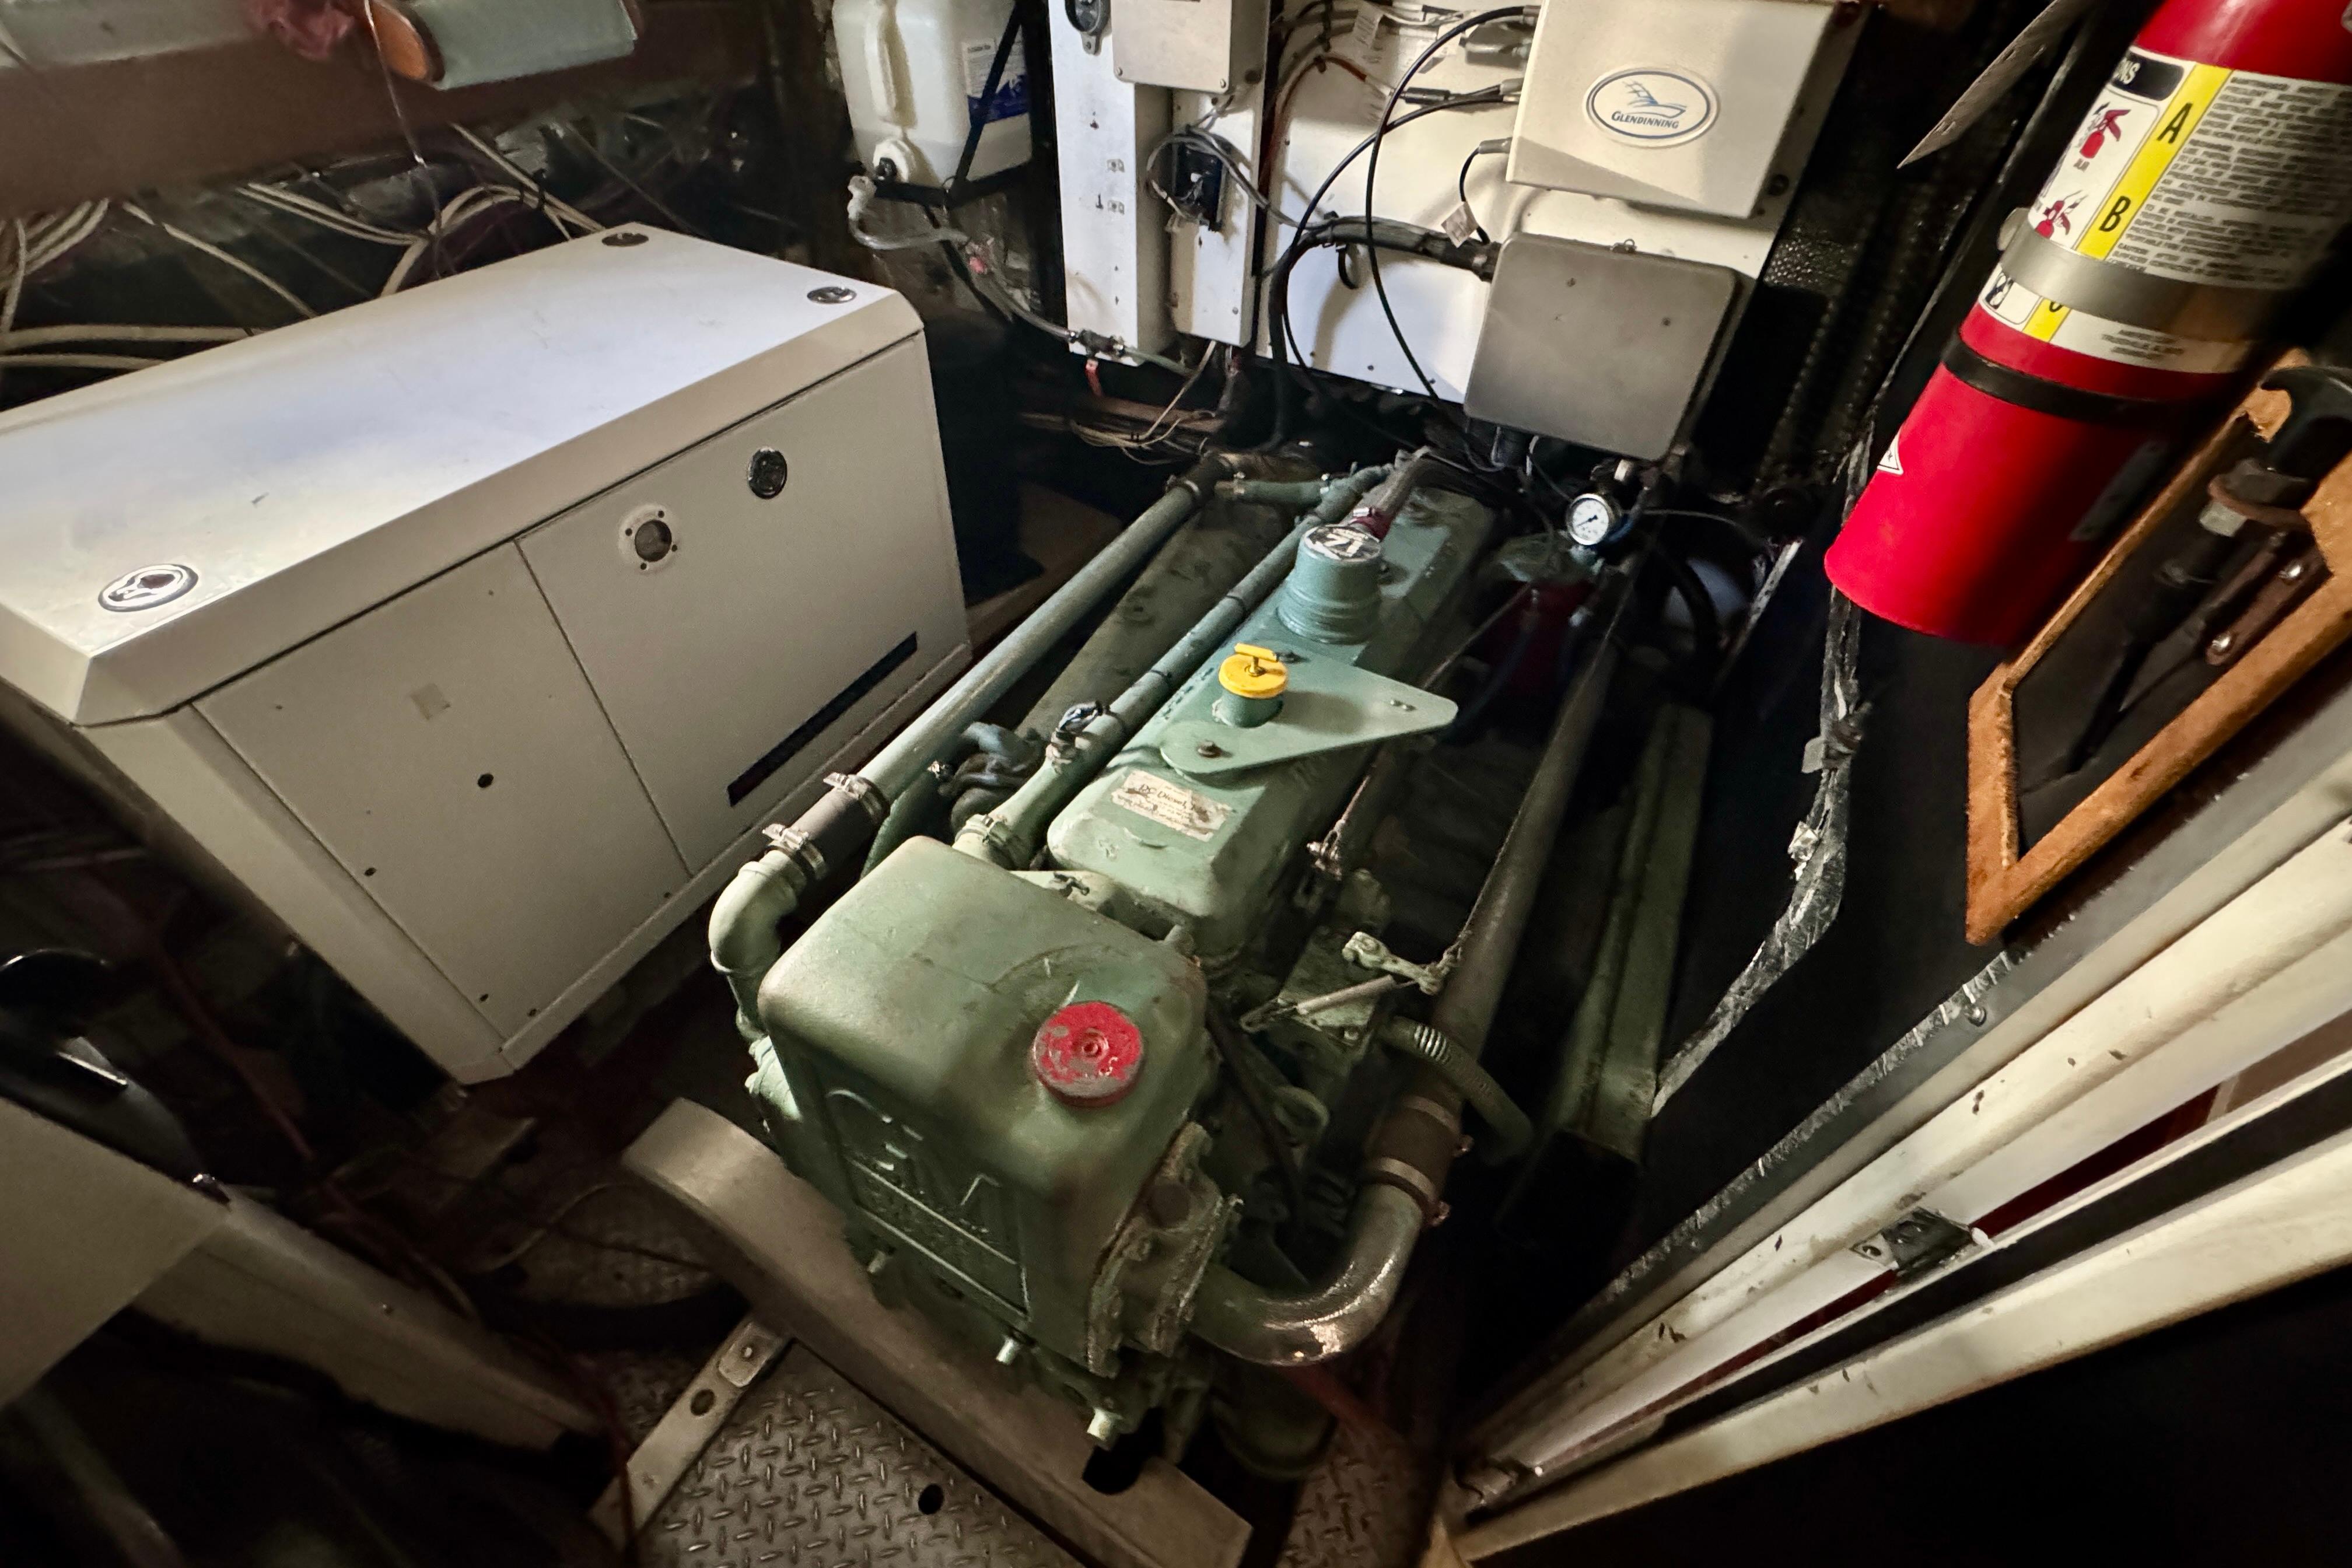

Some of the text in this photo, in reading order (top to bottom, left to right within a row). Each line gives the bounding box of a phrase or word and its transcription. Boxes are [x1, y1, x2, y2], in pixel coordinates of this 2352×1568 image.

[1611, 111, 1679, 129] GLENDINNING
[2156, 102, 2193, 144] A
[2099, 195, 2132, 232] B
